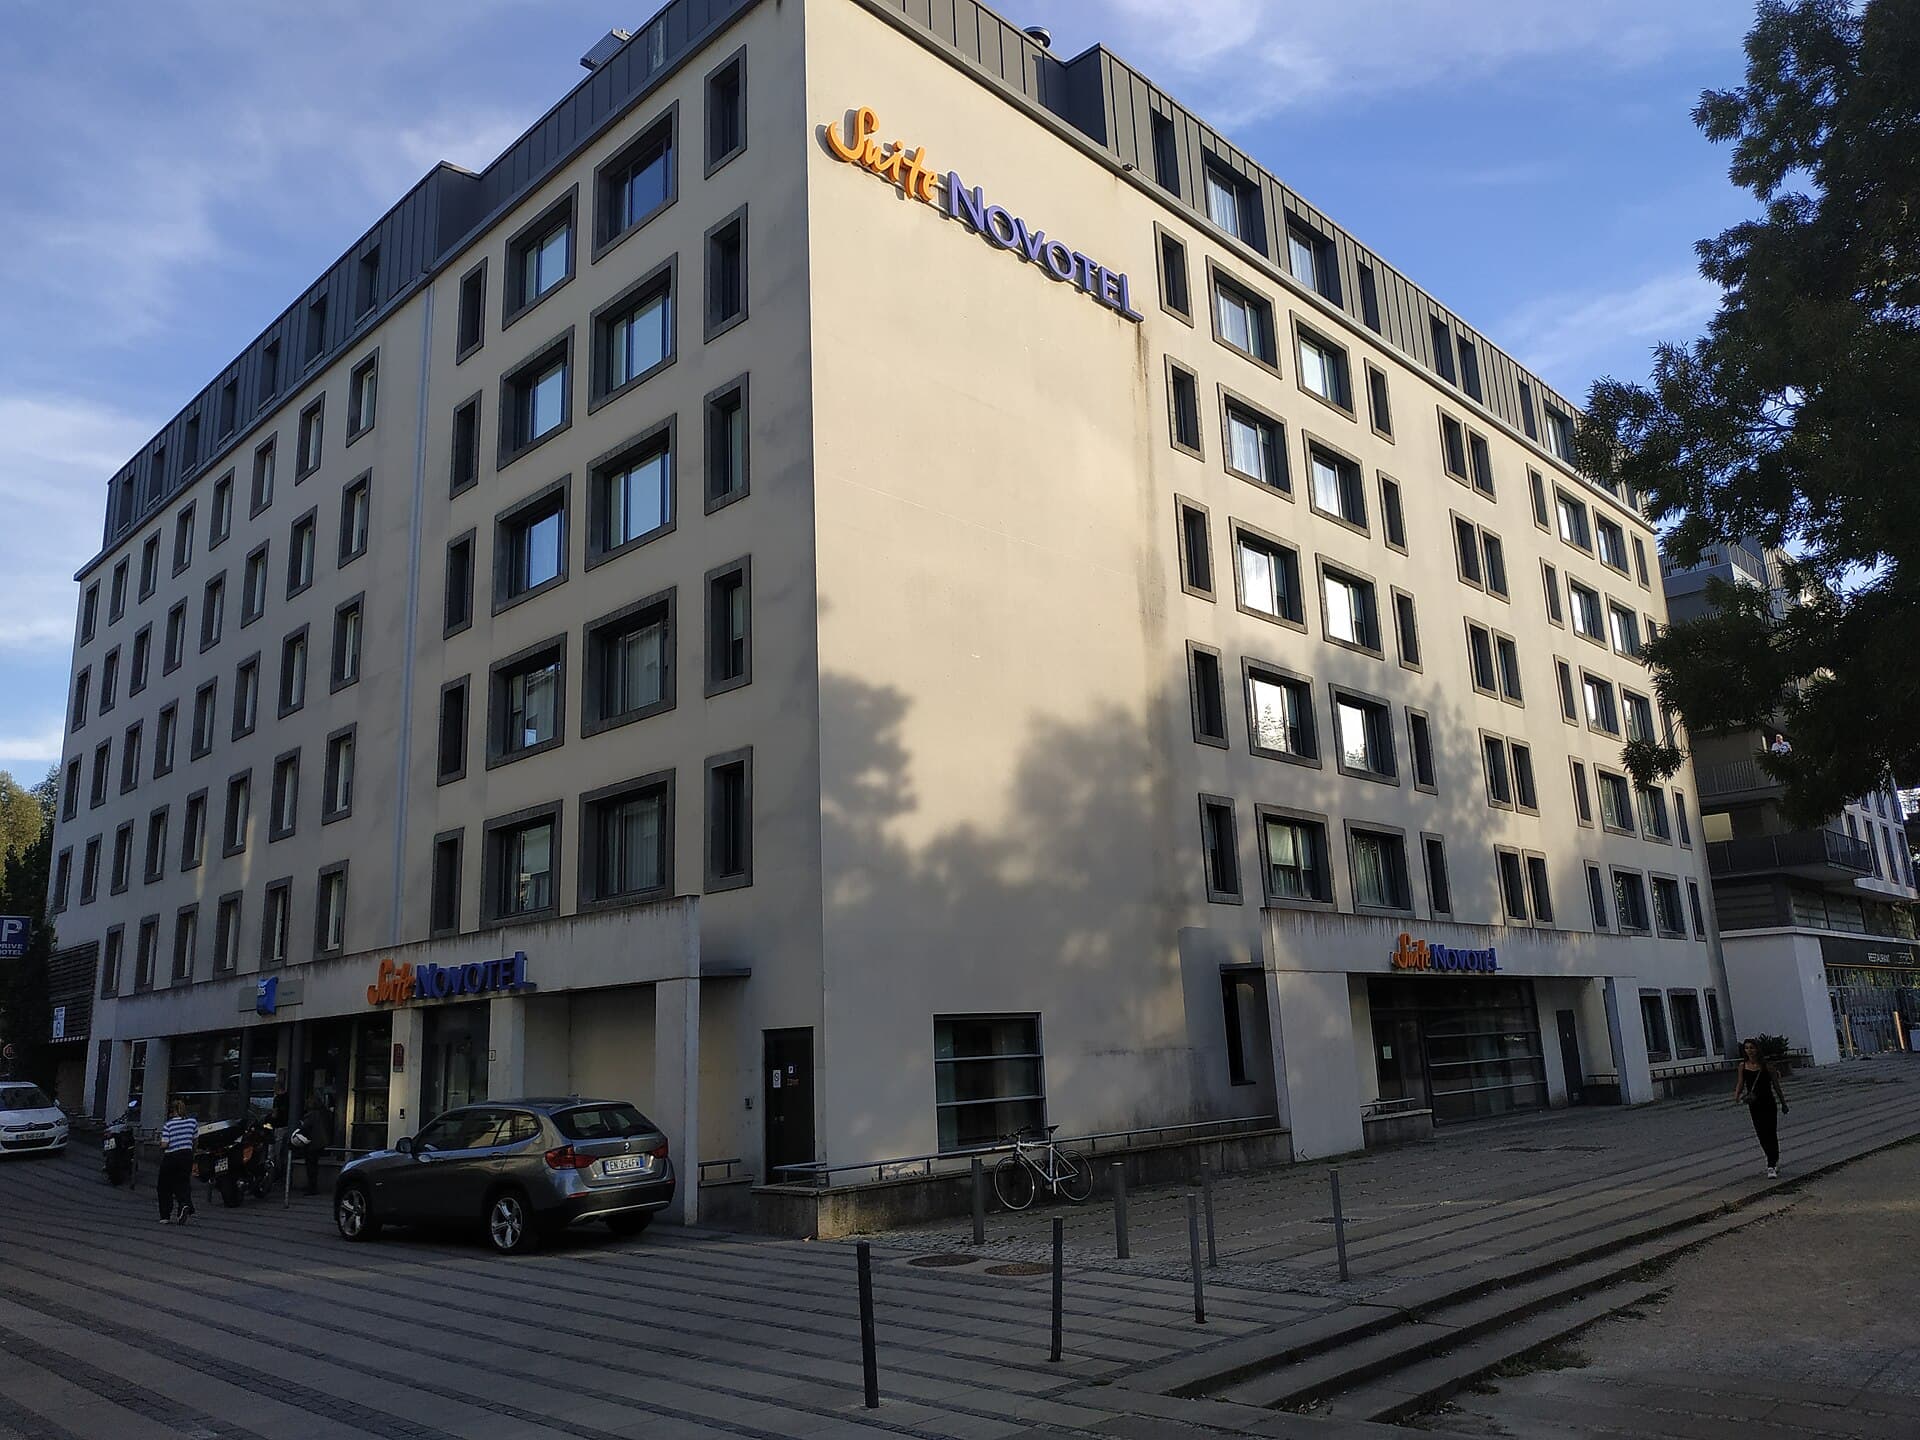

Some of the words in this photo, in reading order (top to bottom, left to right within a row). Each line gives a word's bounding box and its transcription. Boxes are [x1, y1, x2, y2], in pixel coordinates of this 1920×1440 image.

[826, 105, 939, 202] Suite
[947, 171, 1145, 323] NOVOTEL
[1, 919, 23, 942] P
[1393, 933, 1431, 971] Suite
[1429, 942, 1504, 972] NOVOTEL
[368, 959, 416, 1005] Suite
[415, 951, 536, 998] NOVOTEL
